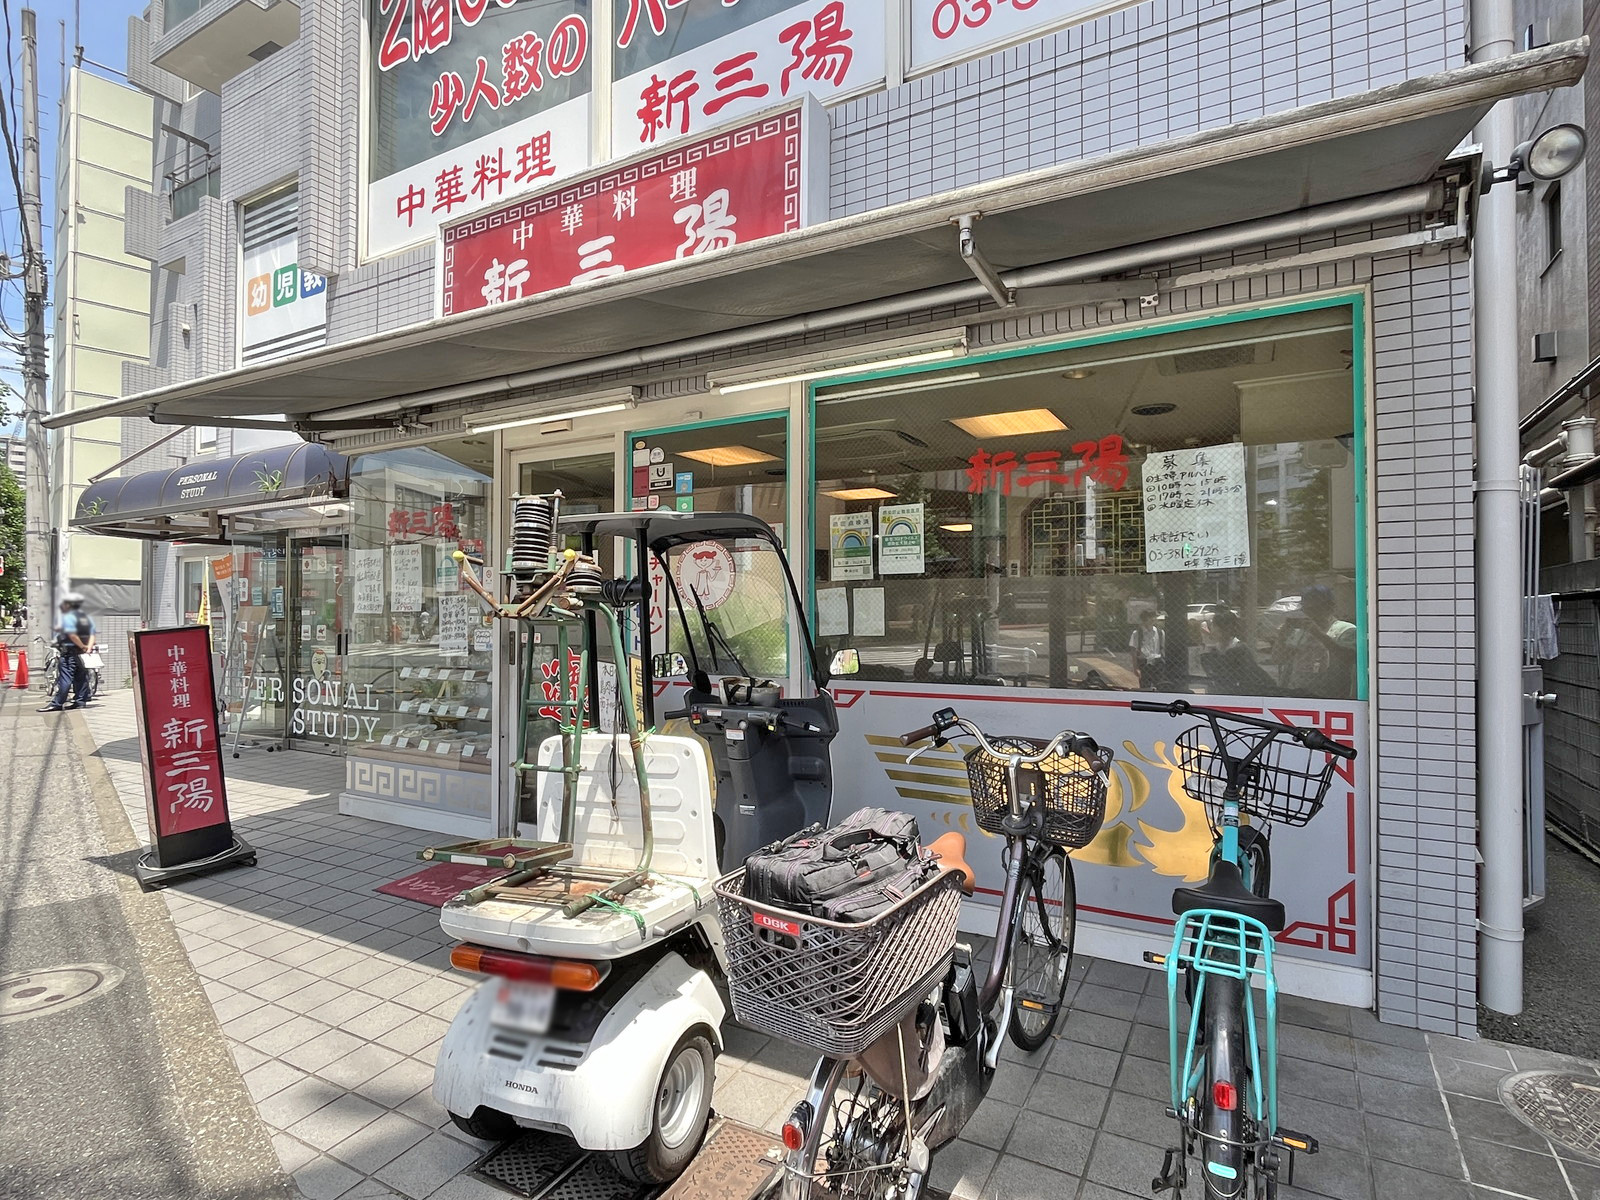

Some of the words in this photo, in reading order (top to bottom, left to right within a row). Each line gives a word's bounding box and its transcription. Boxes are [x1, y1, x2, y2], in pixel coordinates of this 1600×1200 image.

[429, 14, 589, 136] 少人数の
[636, 1, 854, 143] 新三陽
[396, 130, 557, 229] 中華料理
[512, 166, 699, 252] 中華料理
[480, 187, 738, 306] 新三陽
[176, 471, 218, 486] PERSONAL
[180, 486, 207, 499] STUDY
[965, 434, 1131, 496] 新三陽
[387, 502, 461, 541] 新三陽
[167, 644, 192, 709] 中華料理
[292, 708, 381, 743] STUDY
[160, 717, 214, 814] 新三陽
[762, 915, 790, 931] OGK
[504, 1079, 539, 1095] HONDA
